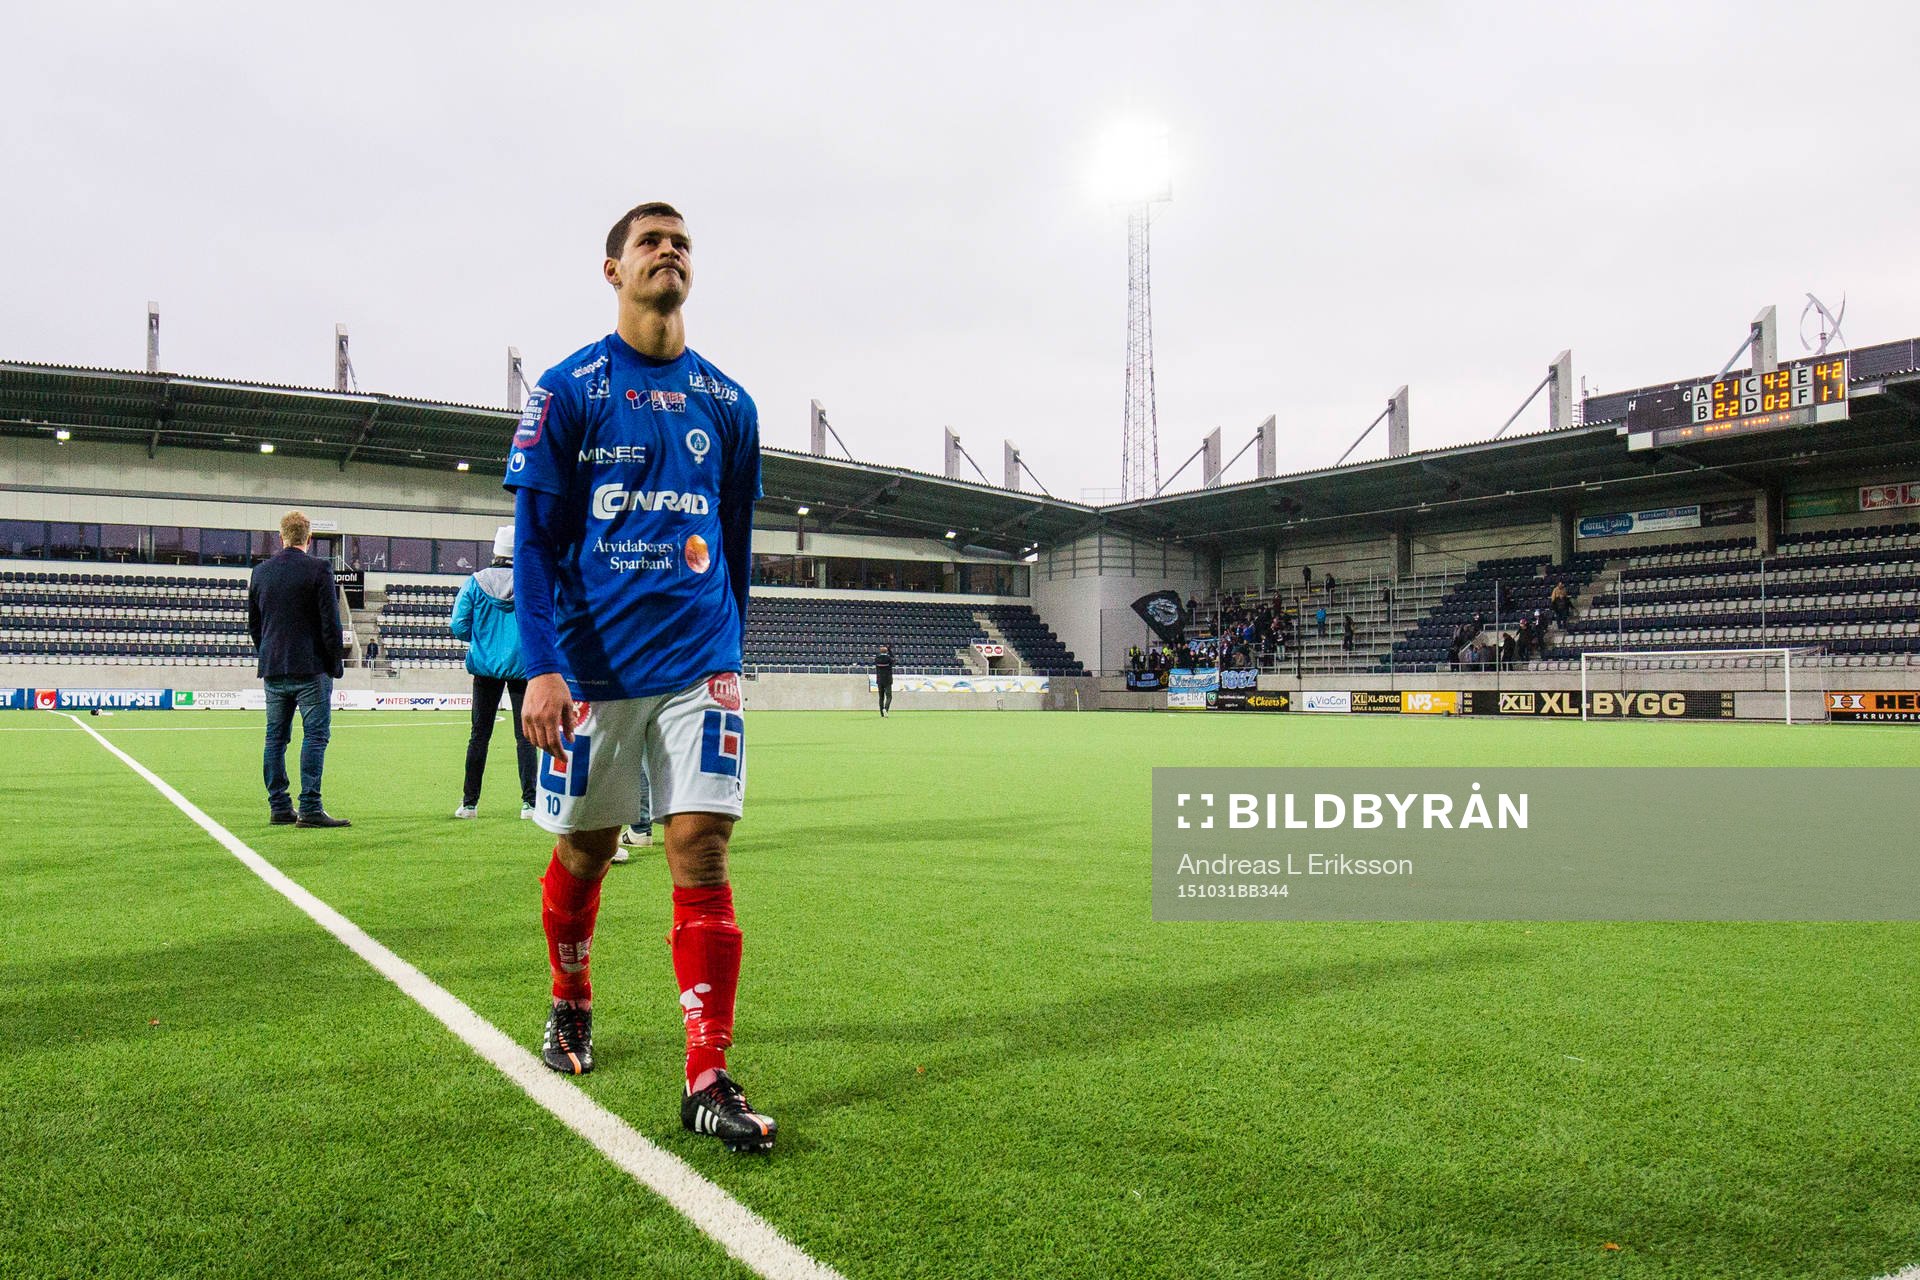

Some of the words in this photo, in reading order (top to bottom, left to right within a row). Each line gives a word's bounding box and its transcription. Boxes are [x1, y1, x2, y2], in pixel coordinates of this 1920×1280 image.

[1697, 387, 1708, 400] A
[1745, 378, 1757, 393] C
[1797, 369, 1808, 385] E
[1683, 391, 1691, 402] G
[1697, 406, 1708, 420] B
[1745, 397, 1758, 413] D
[1798, 388, 1808, 404] F
[652, 400, 686, 413] SPORT
[578, 446, 646, 462] MINEC
[592, 483, 709, 520] CONRAD
[592, 536, 674, 557] Åtvidabergs
[609, 556, 674, 574] Sparbank
[61, 690, 162, 707] STRYKTIPSET
[197, 691, 241, 699] KONTORS-
[198, 698, 231, 706] CENTER
[385, 697, 435, 705] INTERSPORT
[1316, 695, 1347, 705] ViaCon
[1368, 694, 1400, 703] XL-BYGG
[1875, 692, 1920, 709] HE
[546, 793, 561, 816] 10
